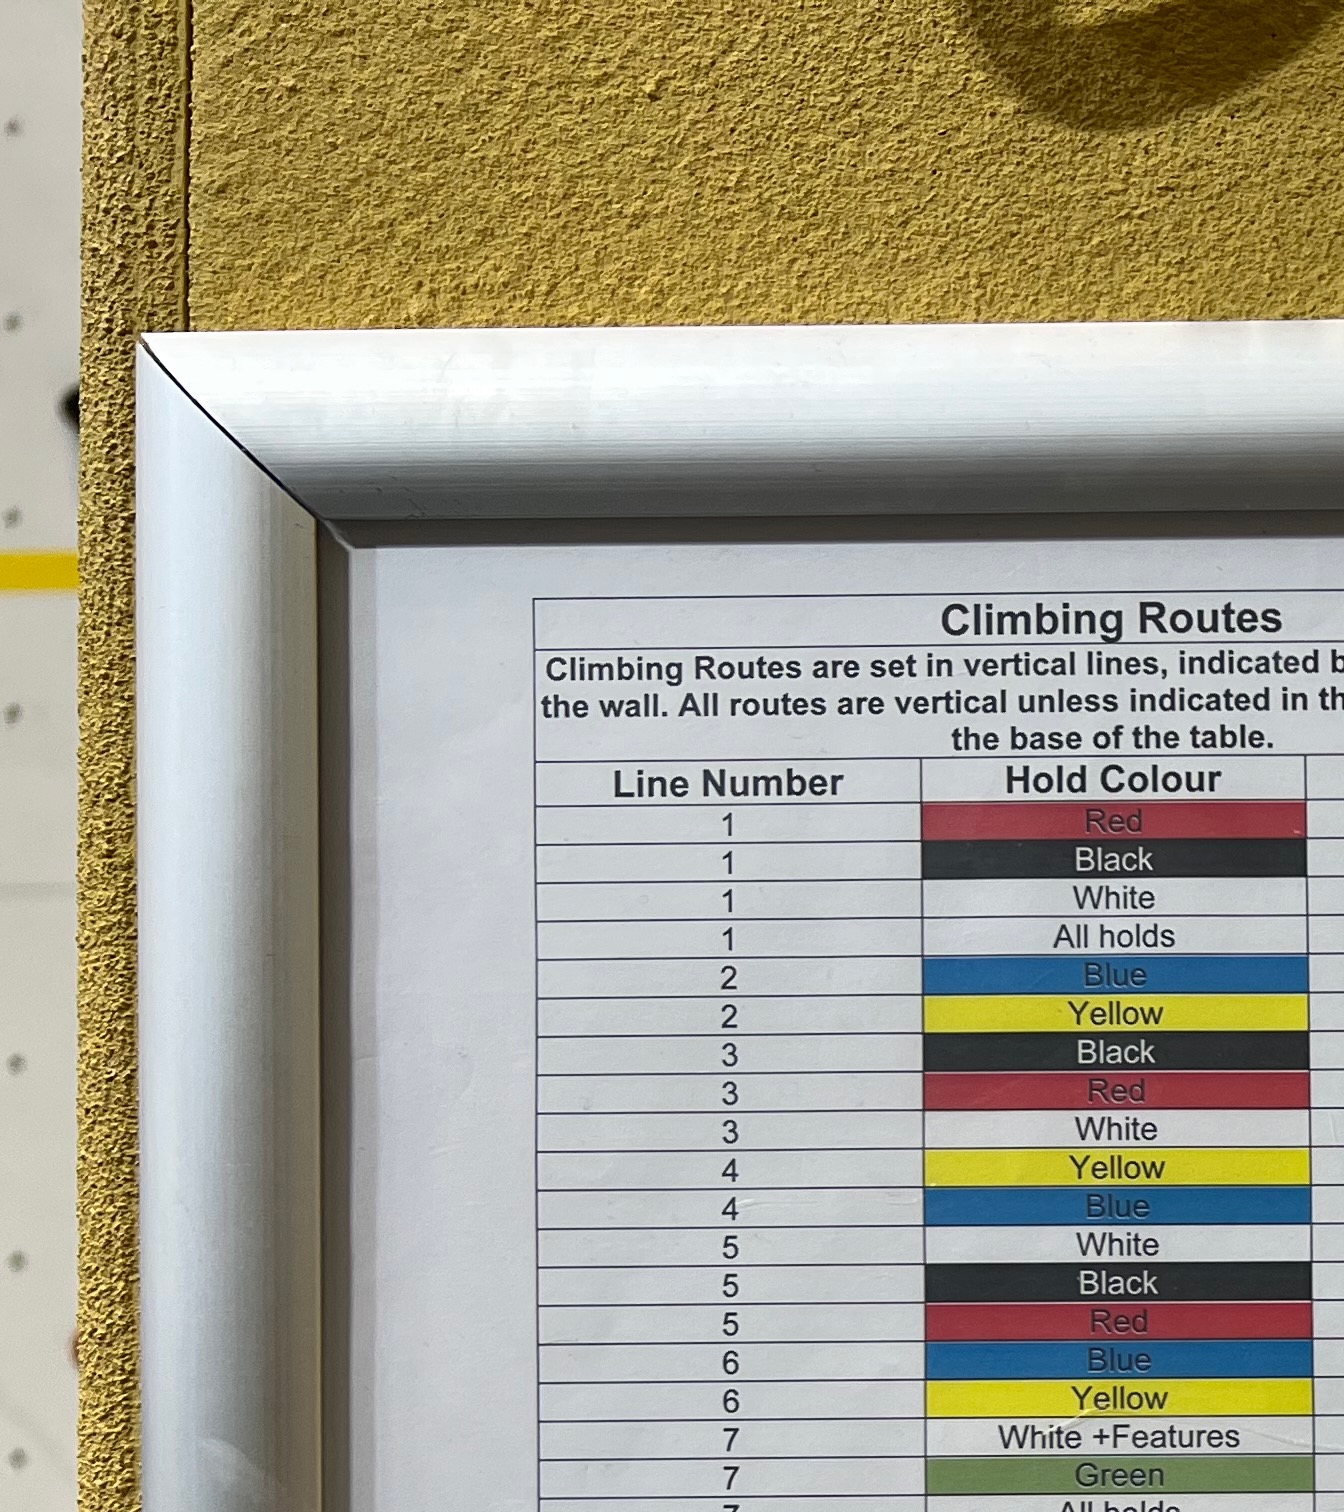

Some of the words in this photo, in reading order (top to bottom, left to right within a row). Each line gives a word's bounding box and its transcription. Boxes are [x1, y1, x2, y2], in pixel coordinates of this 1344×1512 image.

[941, 602, 1123, 641] Climbing
[1139, 601, 1283, 634] Routes
[546, 655, 683, 687] Climbing
[694, 655, 802, 680] Routes
[812, 659, 860, 679] are
[870, 654, 917, 678] set
[927, 652, 953, 677] in
[963, 651, 1076, 677] vertical
[1087, 650, 1168, 680] lines,
[1179, 648, 1320, 675] indicated
[540, 694, 589, 719] the
[598, 693, 668, 718] wall.
[677, 692, 718, 717] All
[730, 692, 827, 717] routes
[837, 696, 885, 716] are
[894, 689, 1007, 715] vertical
[1018, 688, 1119, 714] unless
[1130, 686, 1270, 713] indicated
[1281, 686, 1308, 711] in
[951, 726, 1000, 751] the
[1010, 725, 1083, 751] base
[1092, 724, 1125, 750] of
[1131, 724, 1180, 750] the
[1189, 723, 1274, 749] table.
[614, 769, 689, 798] Line
[702, 767, 845, 797] Number
[1006, 764, 1087, 794] Hold
[1100, 764, 1222, 794] Colour
[722, 812, 733, 837] 1
[1085, 807, 1142, 833] Red
[722, 888, 733, 913] 1
[1072, 885, 1155, 910] White
[721, 1003, 738, 1029] 2
[1067, 1000, 1164, 1026] Yellow
[721, 1196, 739, 1221] 4
[1087, 1193, 1151, 1218] Blue
[723, 1427, 740, 1452] 7
[998, 1424, 1082, 1450] White
[1092, 1423, 1240, 1449] +Features
